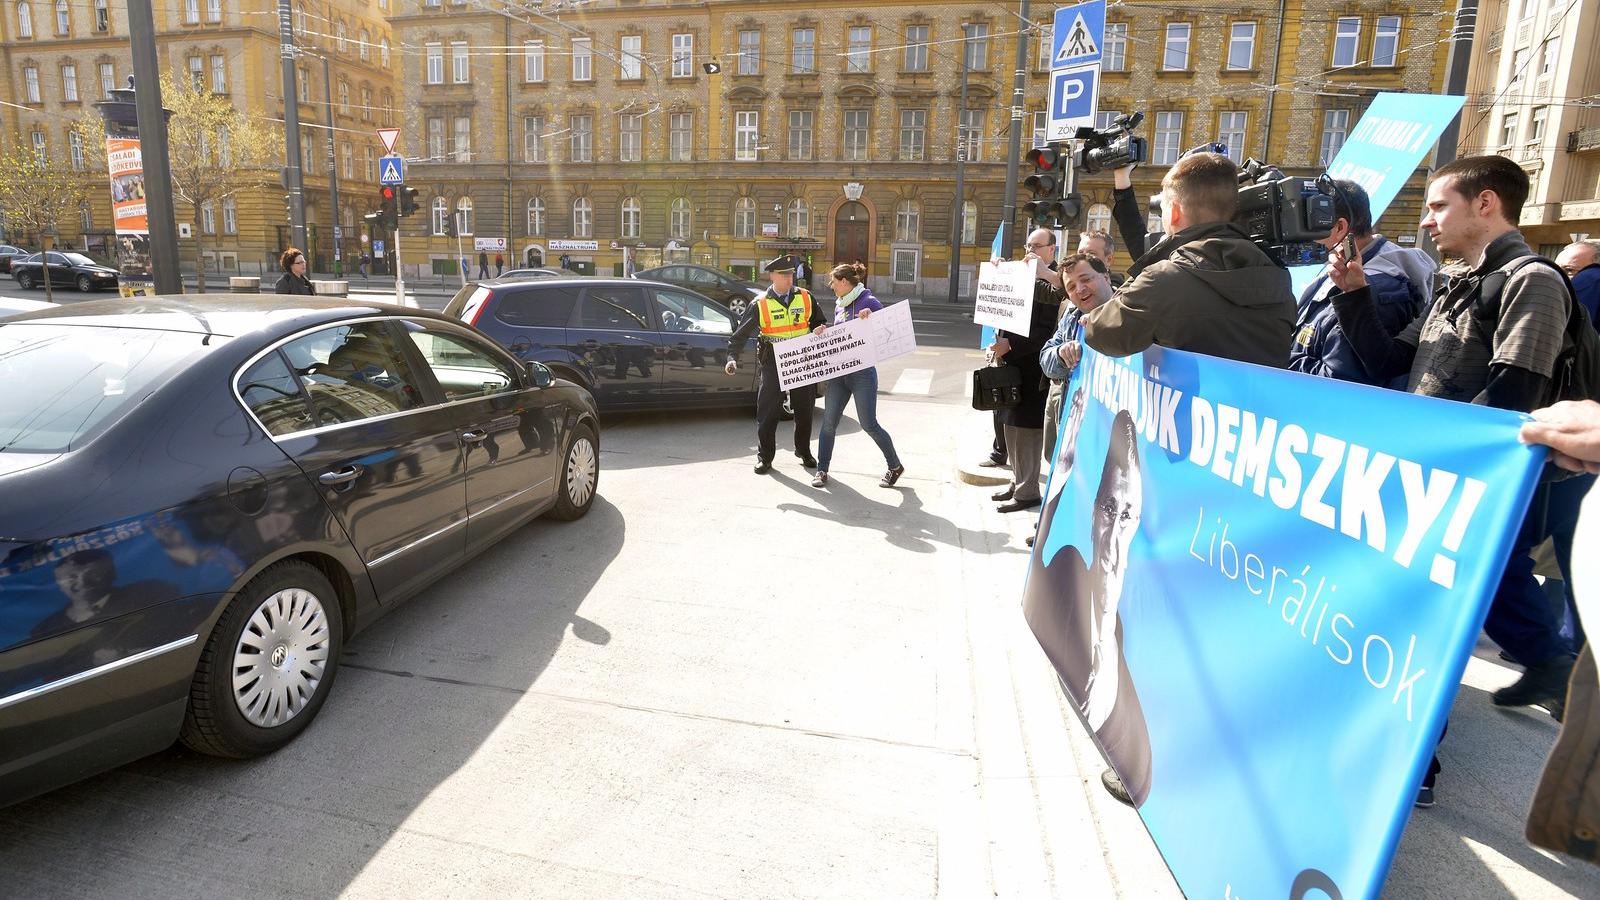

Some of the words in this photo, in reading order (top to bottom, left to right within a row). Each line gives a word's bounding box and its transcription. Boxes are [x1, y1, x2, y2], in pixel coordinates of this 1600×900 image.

[1062, 79, 1084, 114] P
[1058, 124, 1076, 135] ZÓN
[778, 344, 816, 360] VONALJEGY
[816, 340, 829, 350] EGY
[829, 336, 847, 347] ÚTRA
[847, 333, 853, 341] A
[809, 328, 846, 343] VONALJEGY
[780, 347, 840, 368] FŐPOLGÁRMESTERI
[840, 339, 866, 353] HIVATAL
[781, 359, 831, 377] ELHAGYÁSÁRA.
[783, 370, 824, 386] BEVÁLTHATÓ
[825, 366, 841, 376] 2014
[1189, 396, 1487, 590] DEMSZKY!
[1189, 506, 1427, 722] Liberálisok
